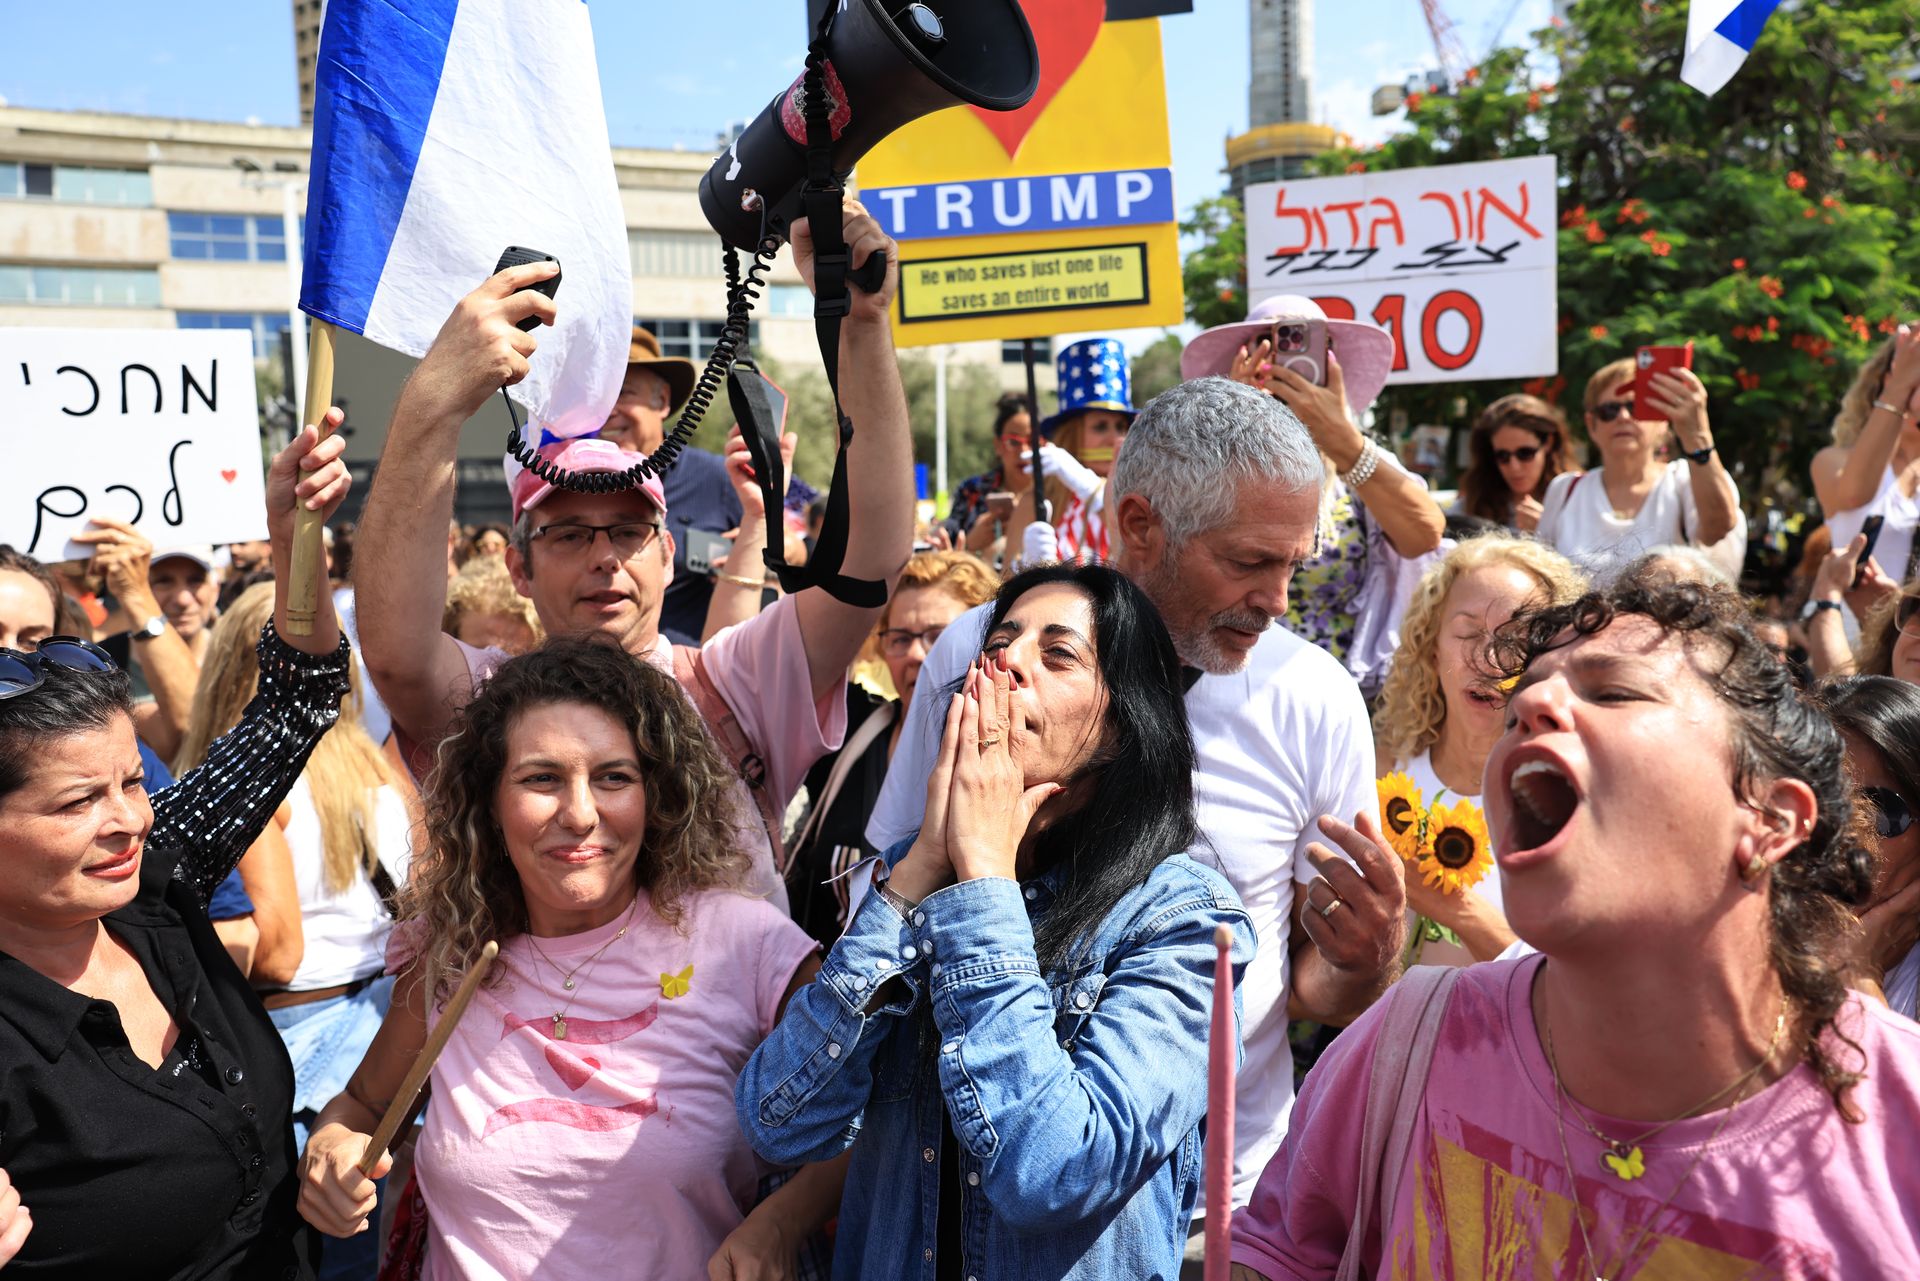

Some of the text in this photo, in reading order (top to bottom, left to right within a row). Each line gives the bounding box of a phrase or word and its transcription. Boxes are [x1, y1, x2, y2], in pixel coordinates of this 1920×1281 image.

[879, 171, 1153, 233] TRUMP
[1275, 181, 1544, 256] אור גדול
[921, 254, 1123, 286] He who saves just one life
[942, 282, 1109, 311] saves an entire world
[1309, 289, 1484, 371] 10
[28, 439, 192, 554] לכם
